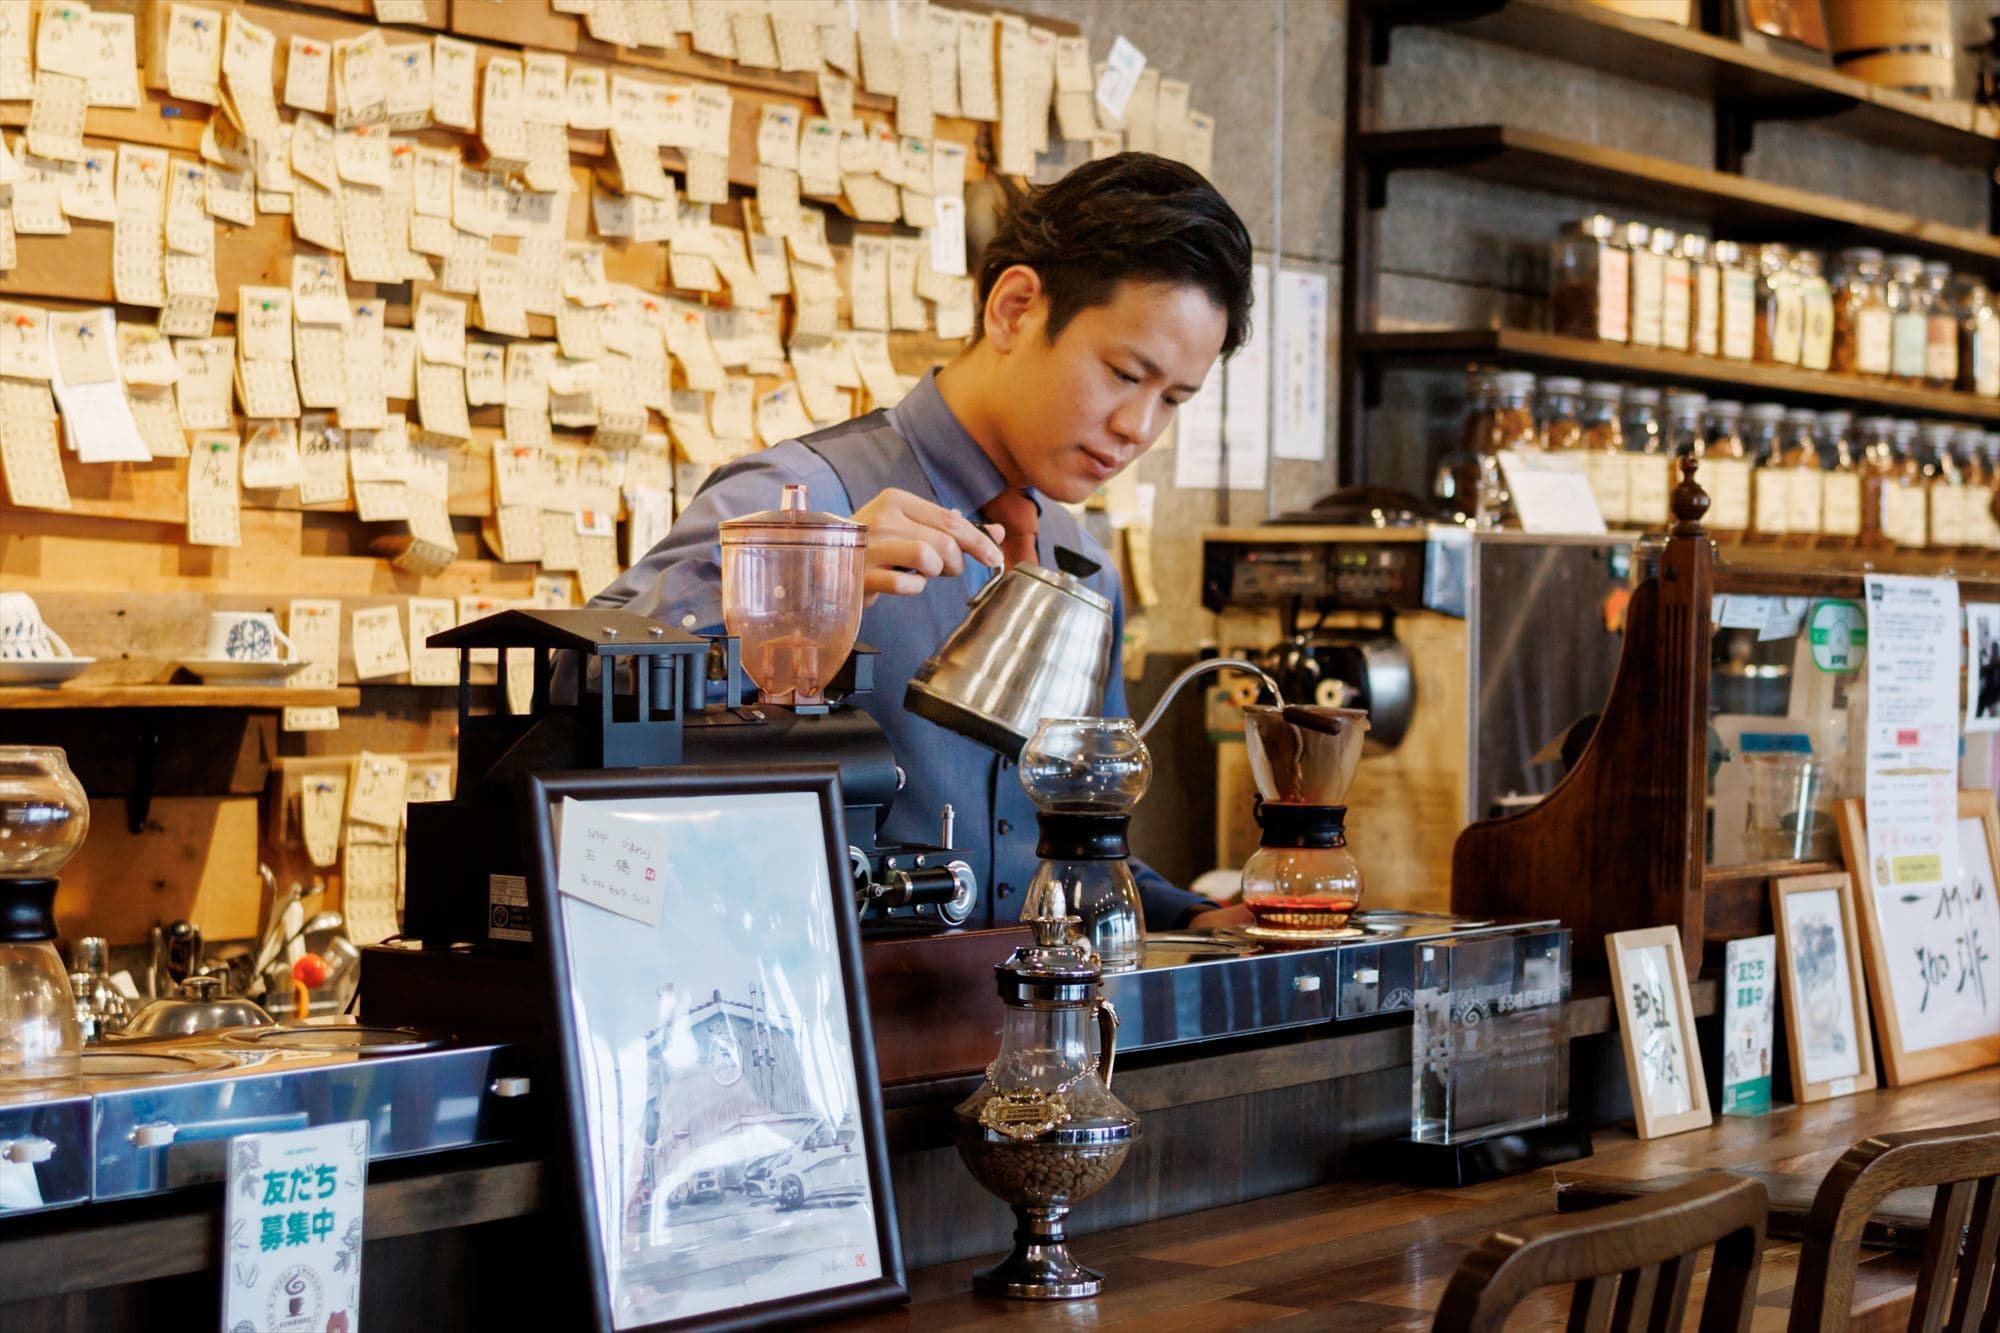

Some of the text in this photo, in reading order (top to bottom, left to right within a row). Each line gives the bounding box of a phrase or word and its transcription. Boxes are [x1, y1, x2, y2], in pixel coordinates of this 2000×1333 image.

[1737, 958, 1765, 983] 友だち
[262, 1162, 338, 1206] 友だち
[259, 1206, 336, 1253] 募集中
